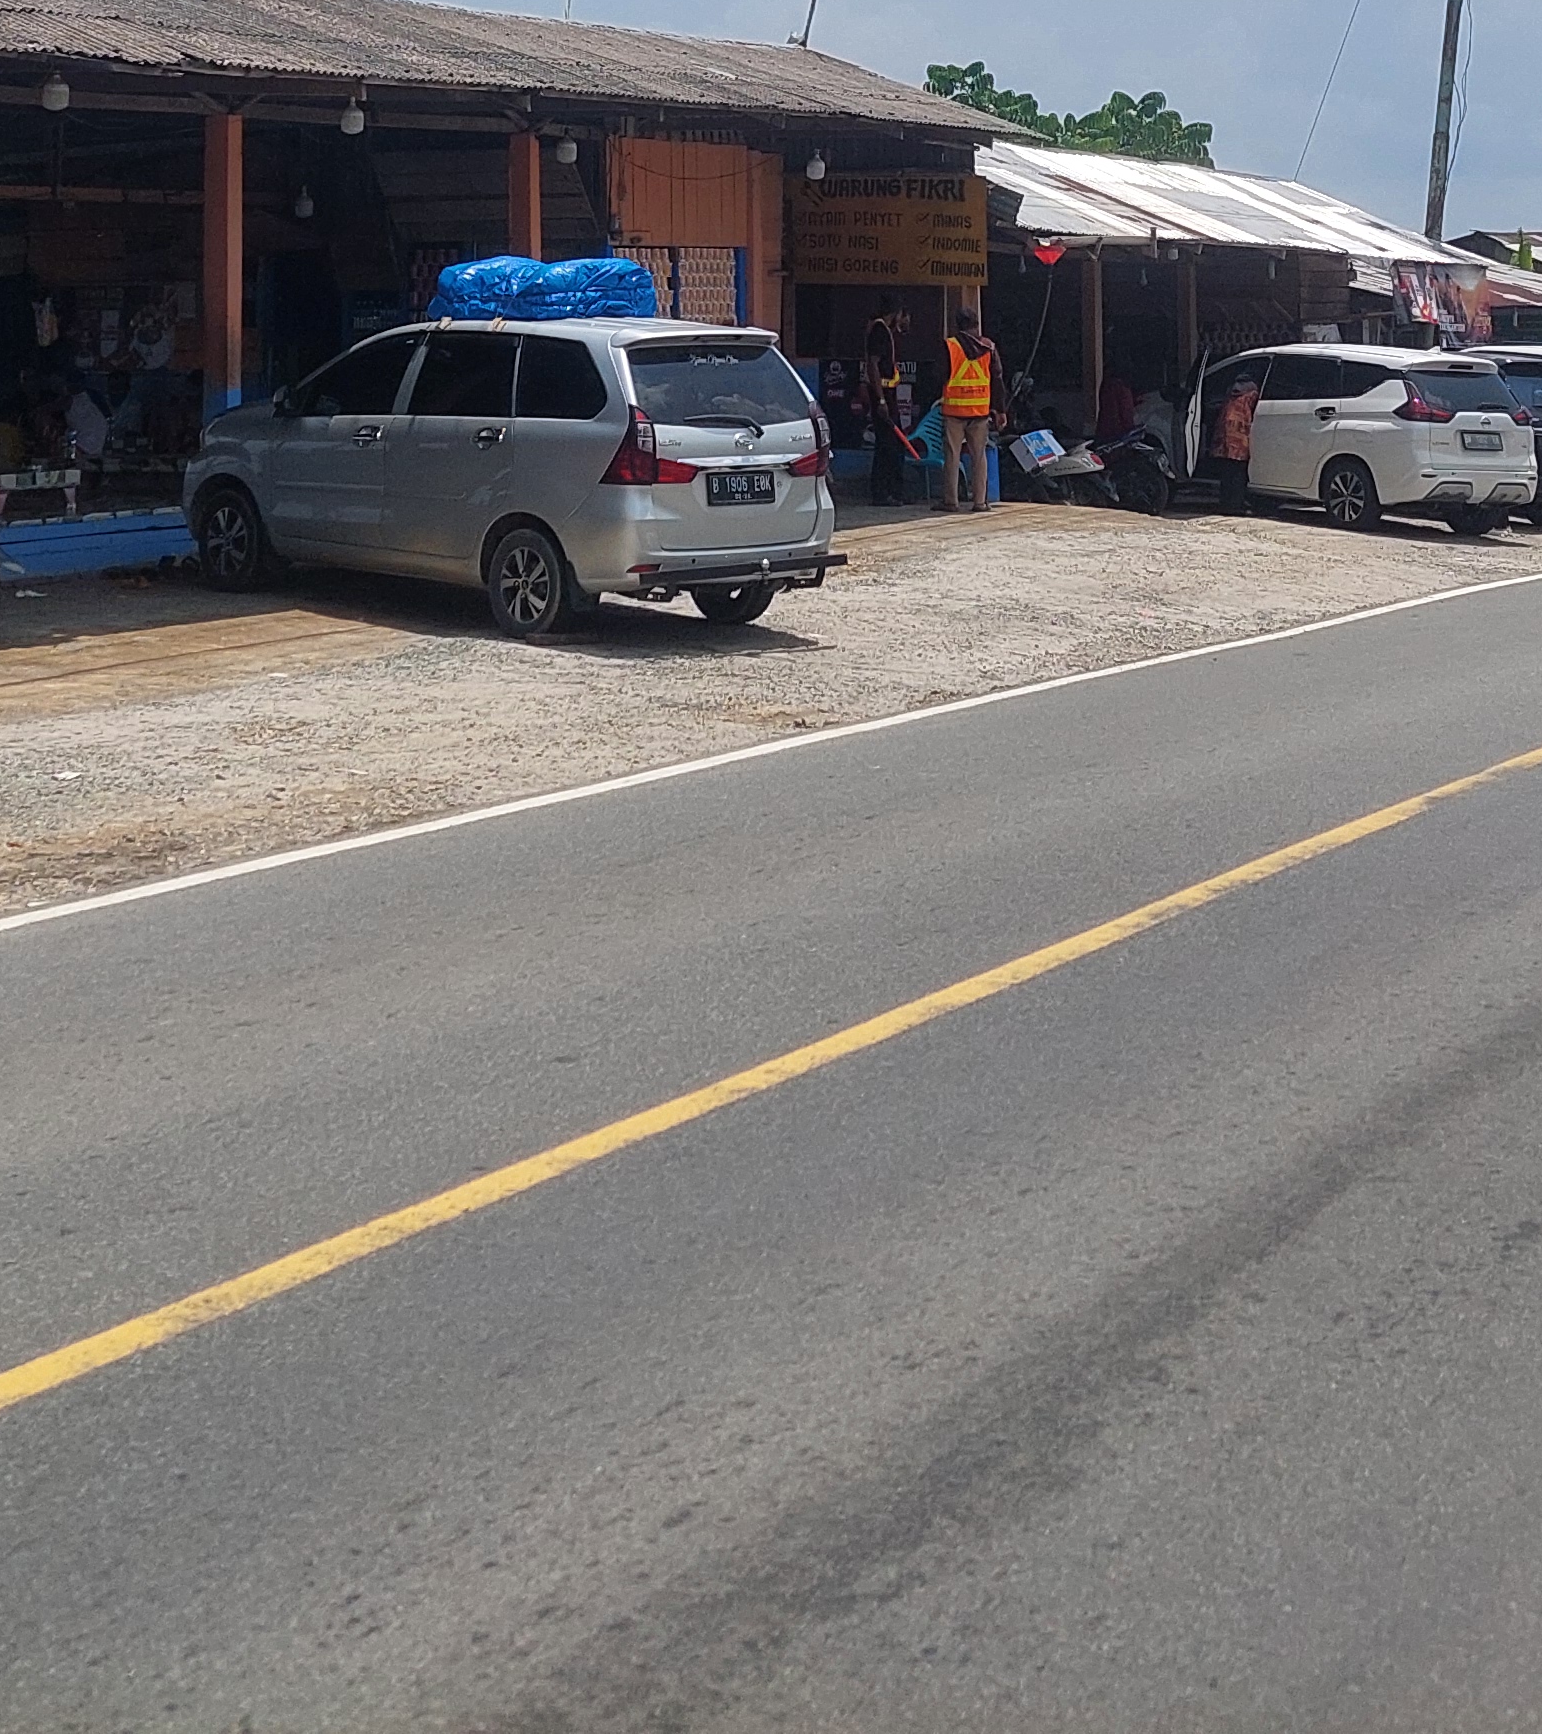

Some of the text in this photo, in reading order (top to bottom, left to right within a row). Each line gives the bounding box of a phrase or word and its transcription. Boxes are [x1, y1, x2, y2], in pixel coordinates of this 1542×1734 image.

[820, 178, 966, 202] WARUNG FIKRI
[853, 211, 904, 228] PENYET
[931, 213, 973, 230] MINAS
[847, 234, 880, 251] NASI
[931, 236, 981, 254] INDOMIE
[807, 257, 899, 275] NASI GORENG
[930, 260, 985, 278] MINUMAN
[712, 476, 720, 494] B
[725, 475, 748, 493] 1906
